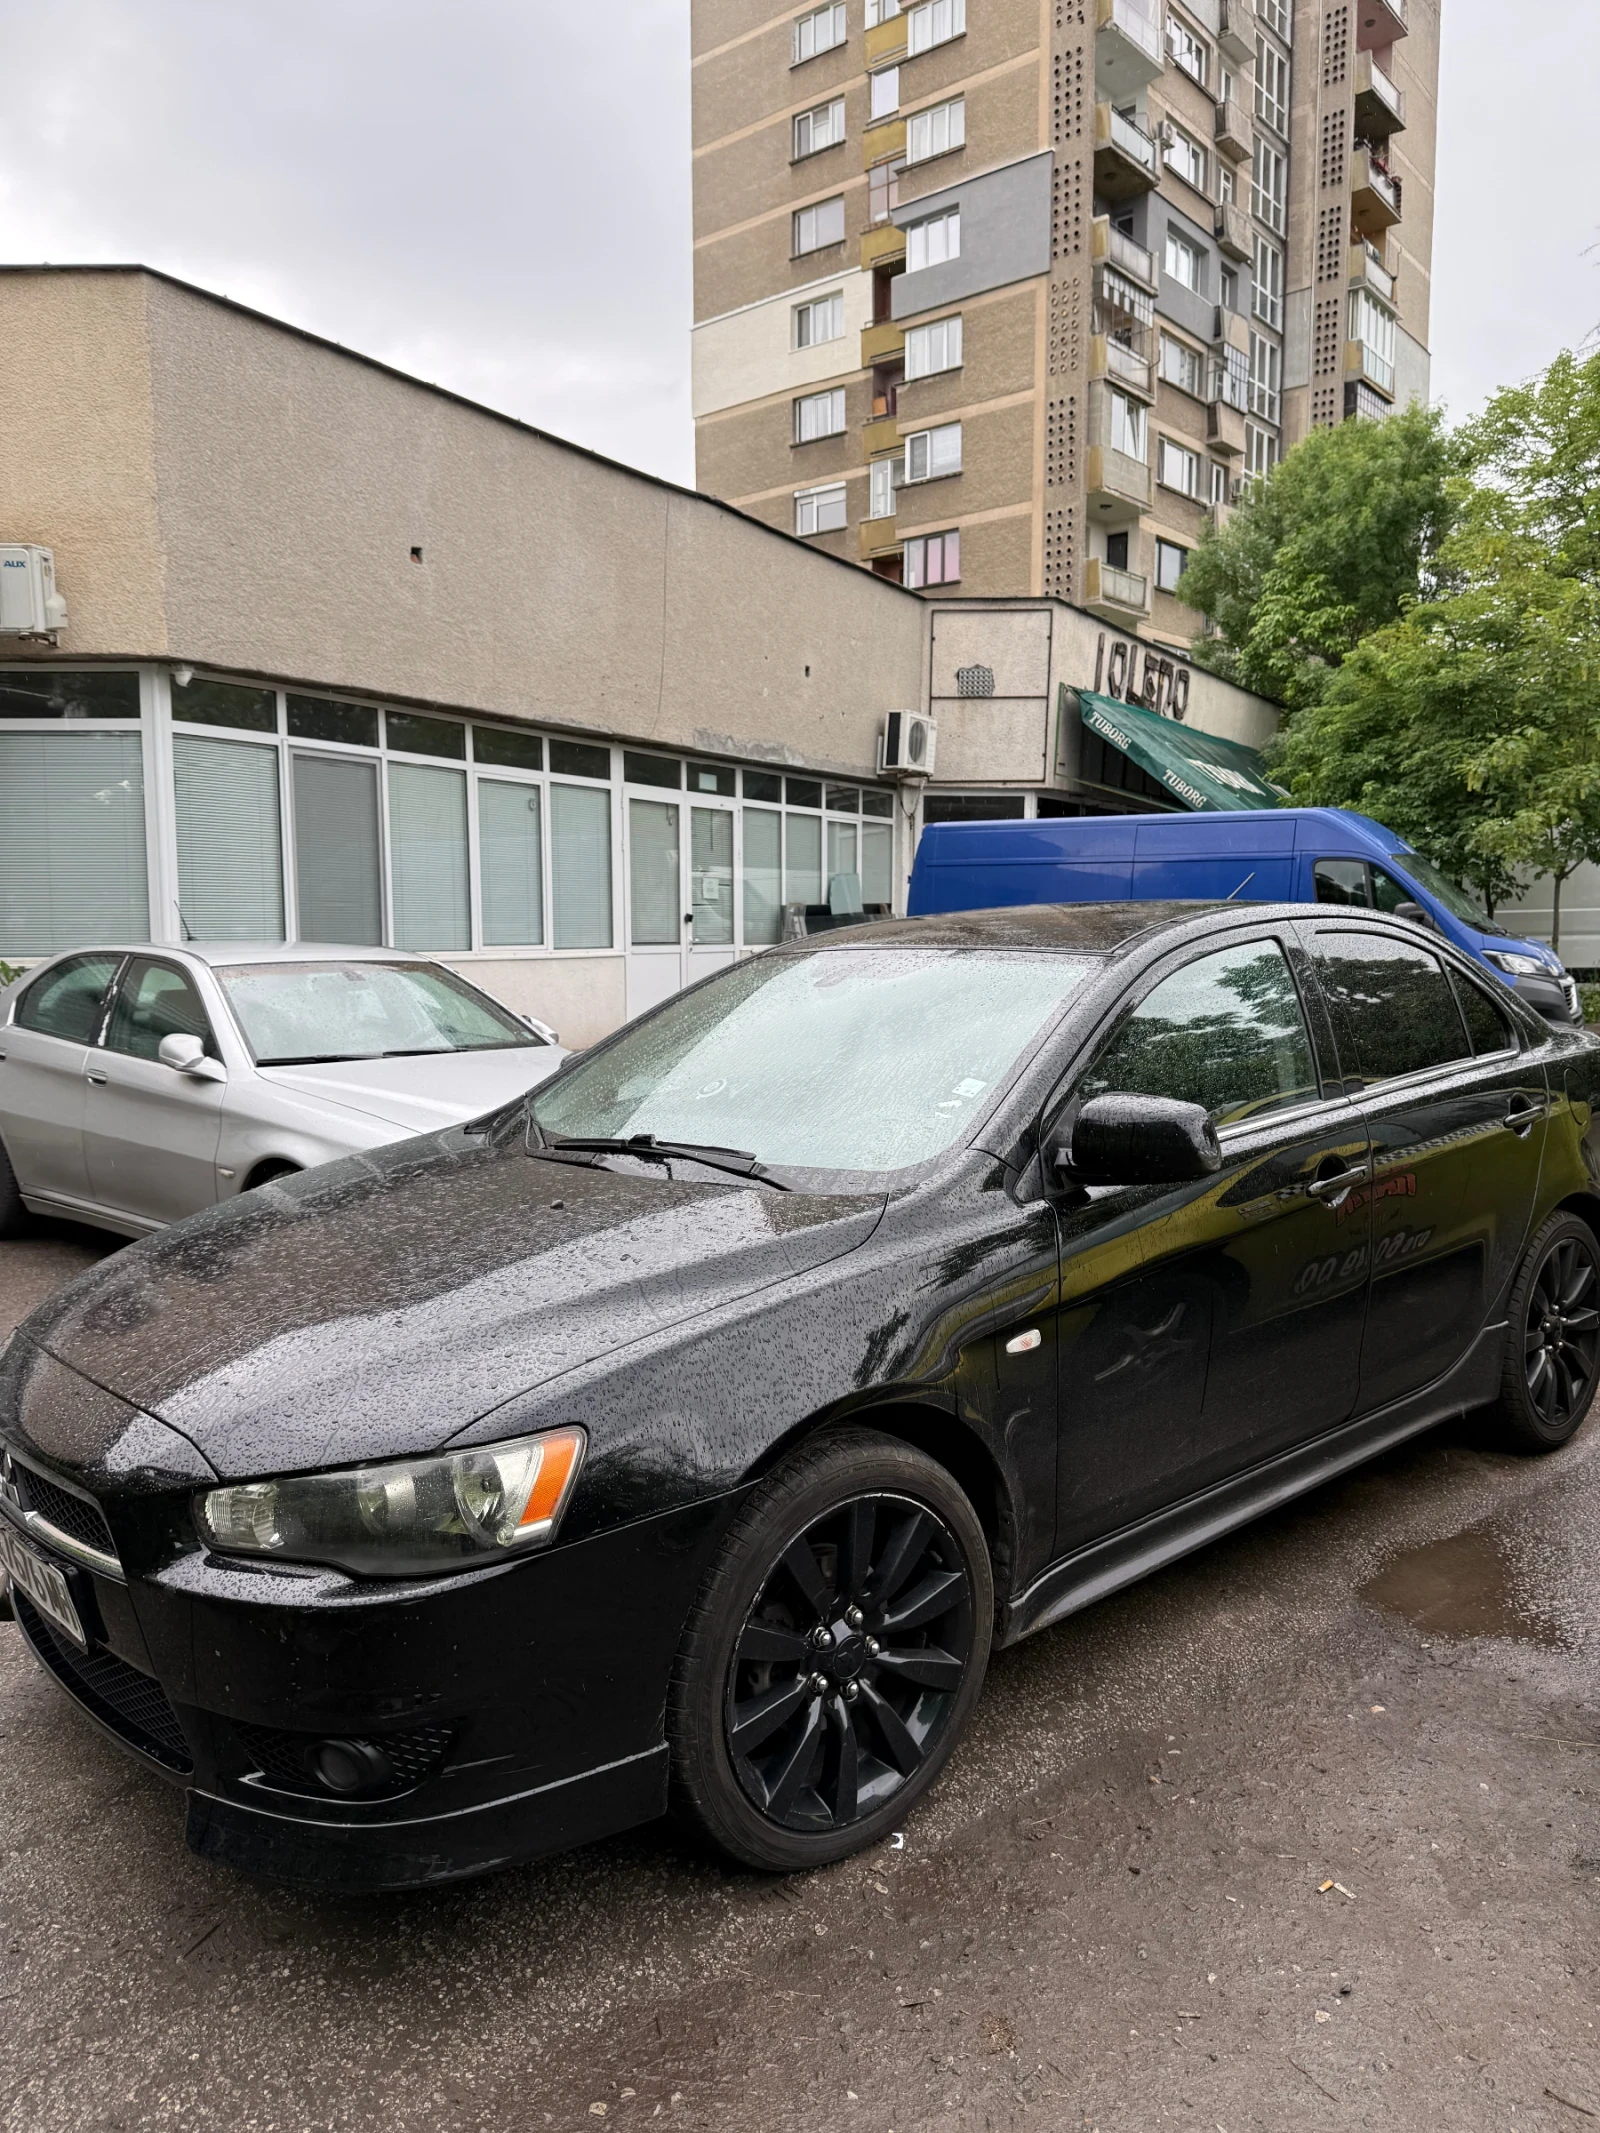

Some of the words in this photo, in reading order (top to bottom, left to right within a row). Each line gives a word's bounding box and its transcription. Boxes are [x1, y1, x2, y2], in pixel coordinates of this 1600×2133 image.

[4, 560, 26, 568] AUX
[1089, 711, 1132, 750] TUBORG
[1162, 769, 1207, 809] TUBORG
